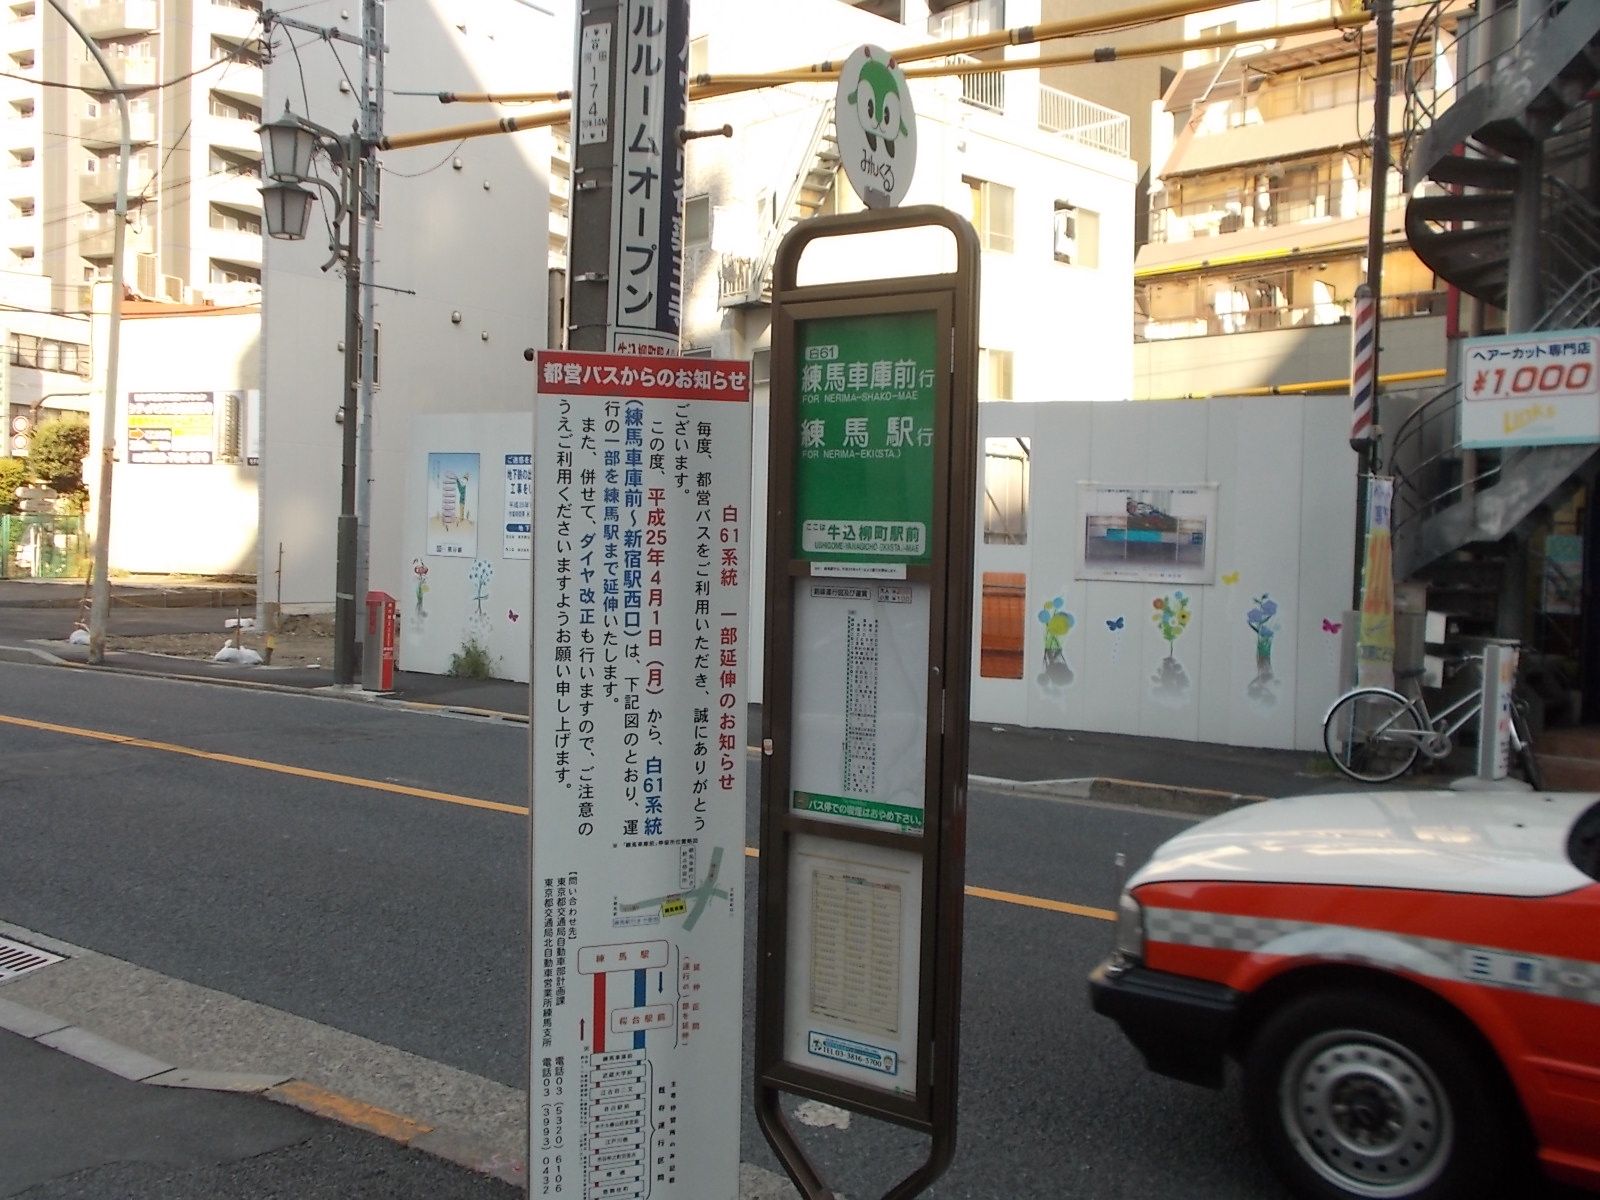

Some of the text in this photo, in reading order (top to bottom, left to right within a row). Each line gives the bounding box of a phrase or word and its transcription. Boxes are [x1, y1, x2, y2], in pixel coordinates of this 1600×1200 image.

[1473, 342, 1591, 361] ヘアーカット専門店
[543, 362, 747, 391] 都営バスからのお知らせ
[802, 394, 820, 404] FOR
[674, 403, 691, 495] ございます。
[802, 450, 819, 460] FOR
[827, 524, 921, 543] 牛込柳町駅前
